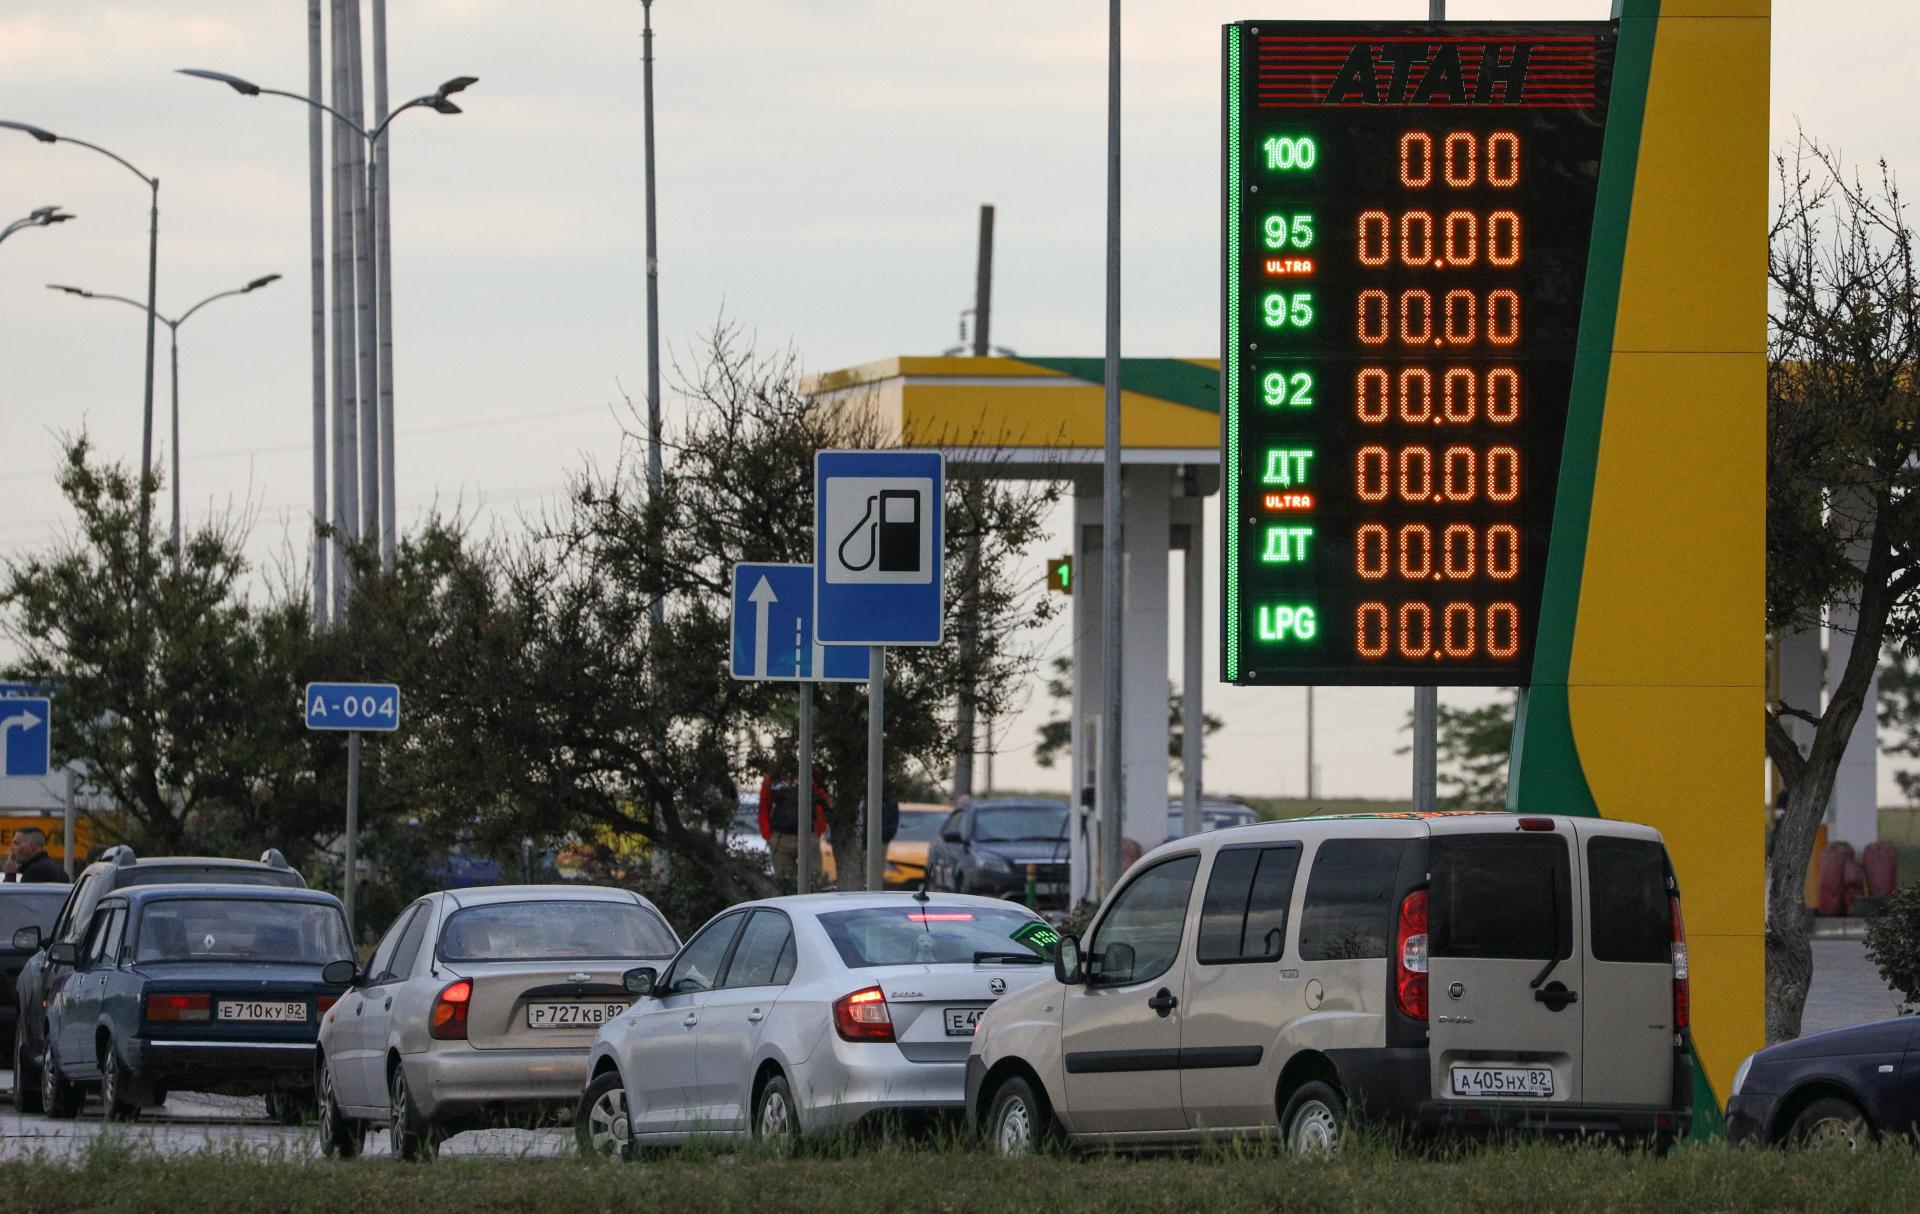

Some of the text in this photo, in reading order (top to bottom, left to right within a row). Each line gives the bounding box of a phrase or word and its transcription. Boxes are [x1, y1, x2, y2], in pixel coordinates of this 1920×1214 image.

[1322, 43, 1532, 105] АТАН
[1264, 132, 1519, 187] 100 000
[1264, 211, 1519, 268] 95 00.00
[1266, 260, 1312, 273] ULTRA
[1264, 290, 1519, 346] 95 00.00
[1264, 368, 1518, 424] 92 00.00
[1263, 446, 1518, 503] ДТ 00.00
[1265, 495, 1311, 508] ULTRA
[1057, 563, 1069, 587] 1
[1262, 524, 1518, 581] ДТ 00.00
[1258, 602, 1518, 659] LPG 00.00
